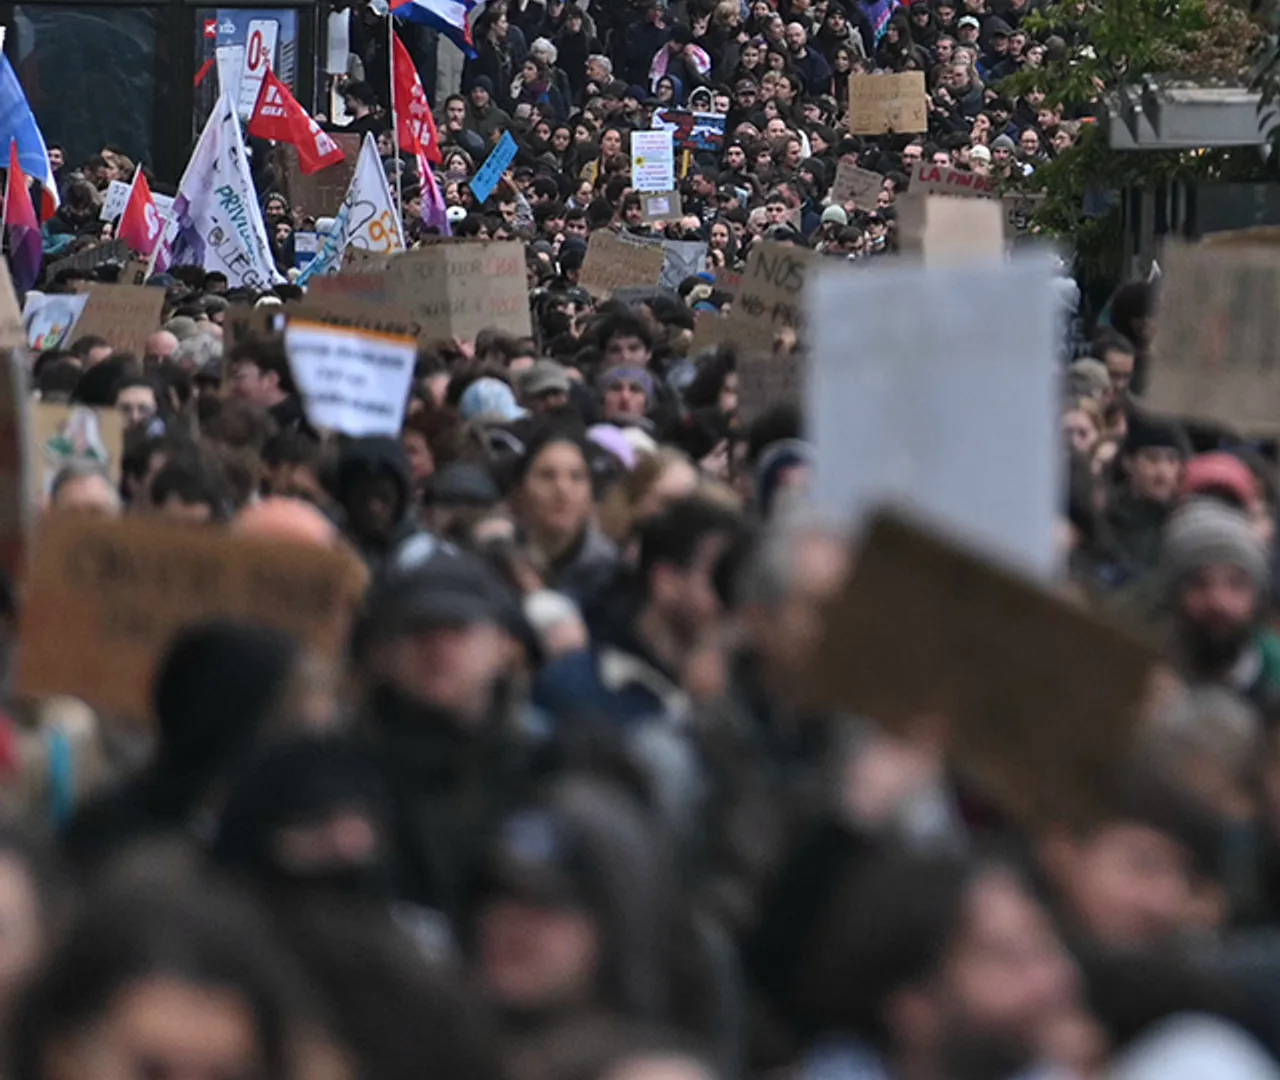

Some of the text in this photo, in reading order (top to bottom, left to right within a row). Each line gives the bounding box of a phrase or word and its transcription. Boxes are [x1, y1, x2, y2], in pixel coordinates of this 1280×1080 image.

[919, 167, 941, 182] LA
[946, 170, 973, 186] FIN
[753, 251, 805, 293] NOS
